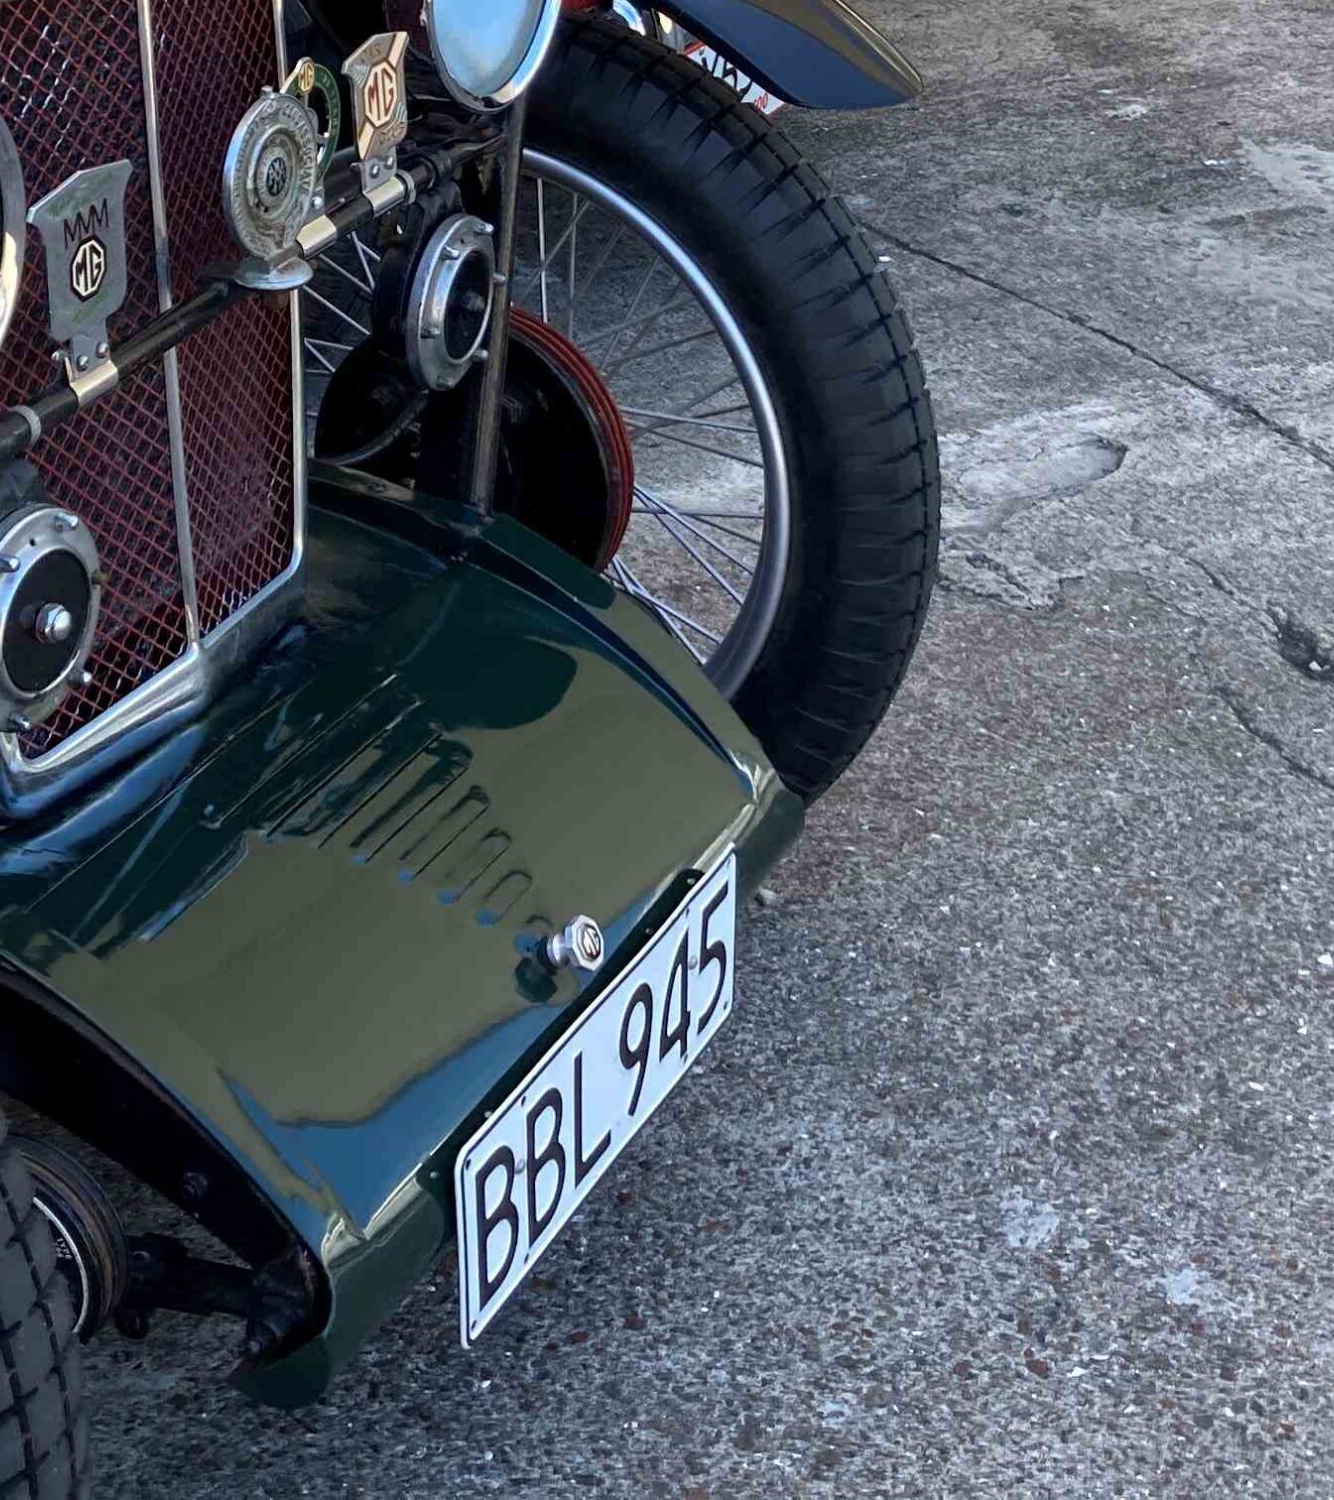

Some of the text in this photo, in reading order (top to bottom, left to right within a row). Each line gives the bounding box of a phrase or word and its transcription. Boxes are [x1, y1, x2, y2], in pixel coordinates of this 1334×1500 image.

[368, 67, 394, 119] MG
[75, 244, 103, 293] MG
[475, 880, 729, 1312] BBL 945
